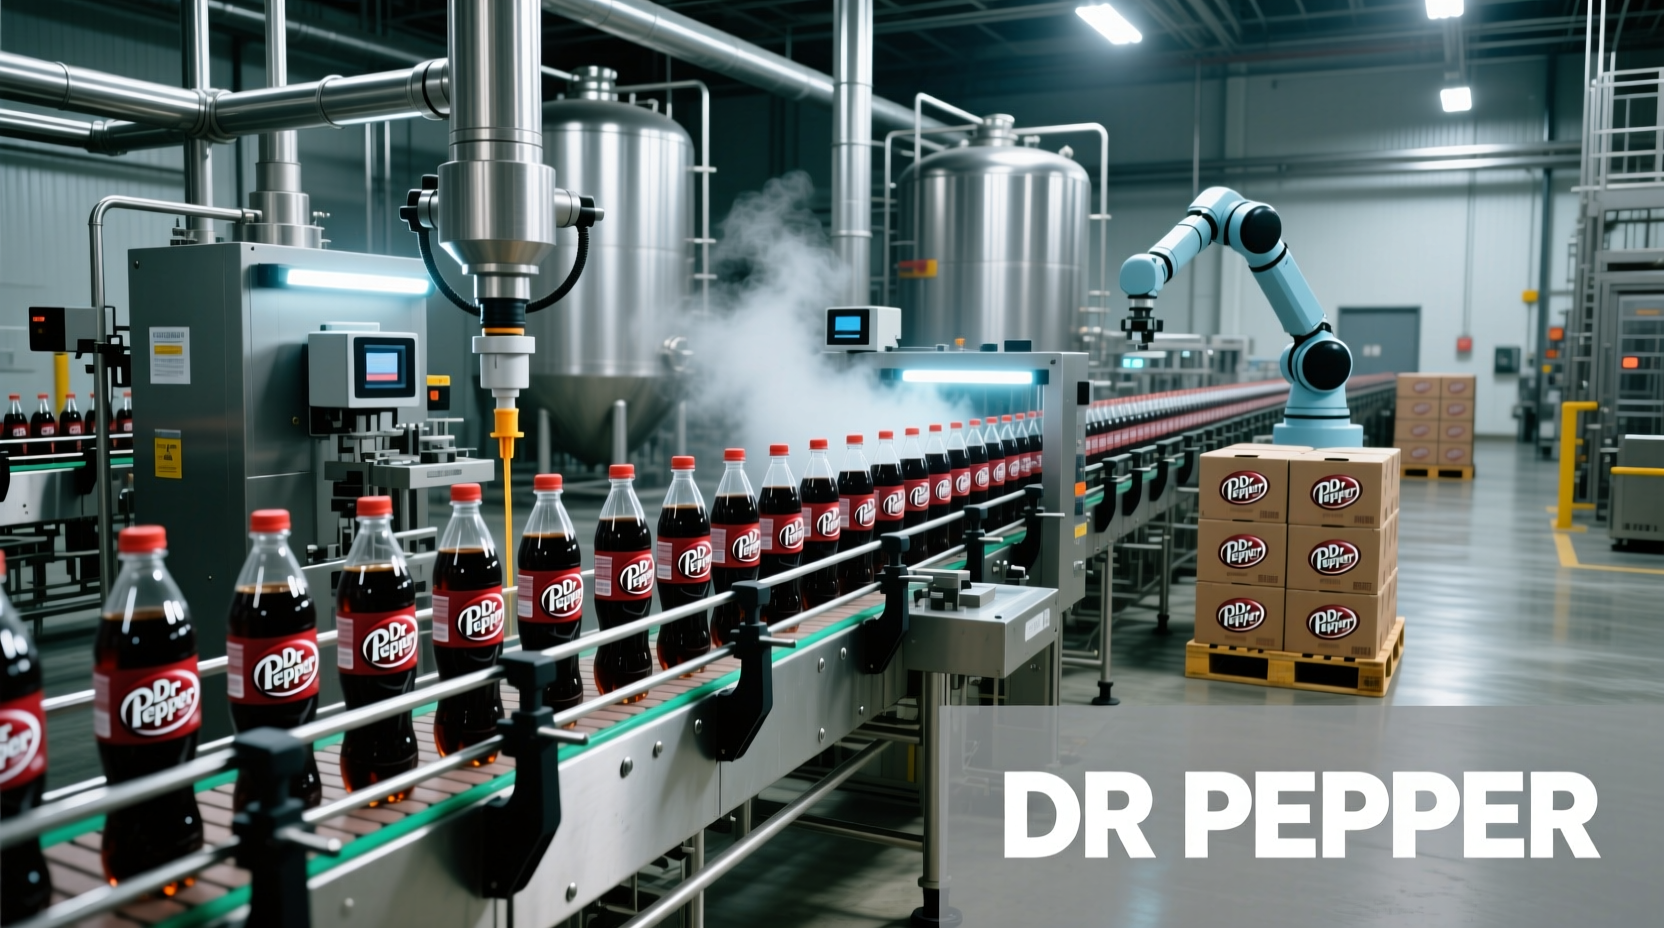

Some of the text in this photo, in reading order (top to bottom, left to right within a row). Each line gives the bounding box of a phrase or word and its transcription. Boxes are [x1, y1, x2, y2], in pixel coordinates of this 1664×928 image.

[481, 599, 498, 617] Dr
[388, 622, 407, 642] Dr
[282, 647, 305, 670] Dr
[152, 679, 181, 703] Dr
[0, 723, 13, 743] r
